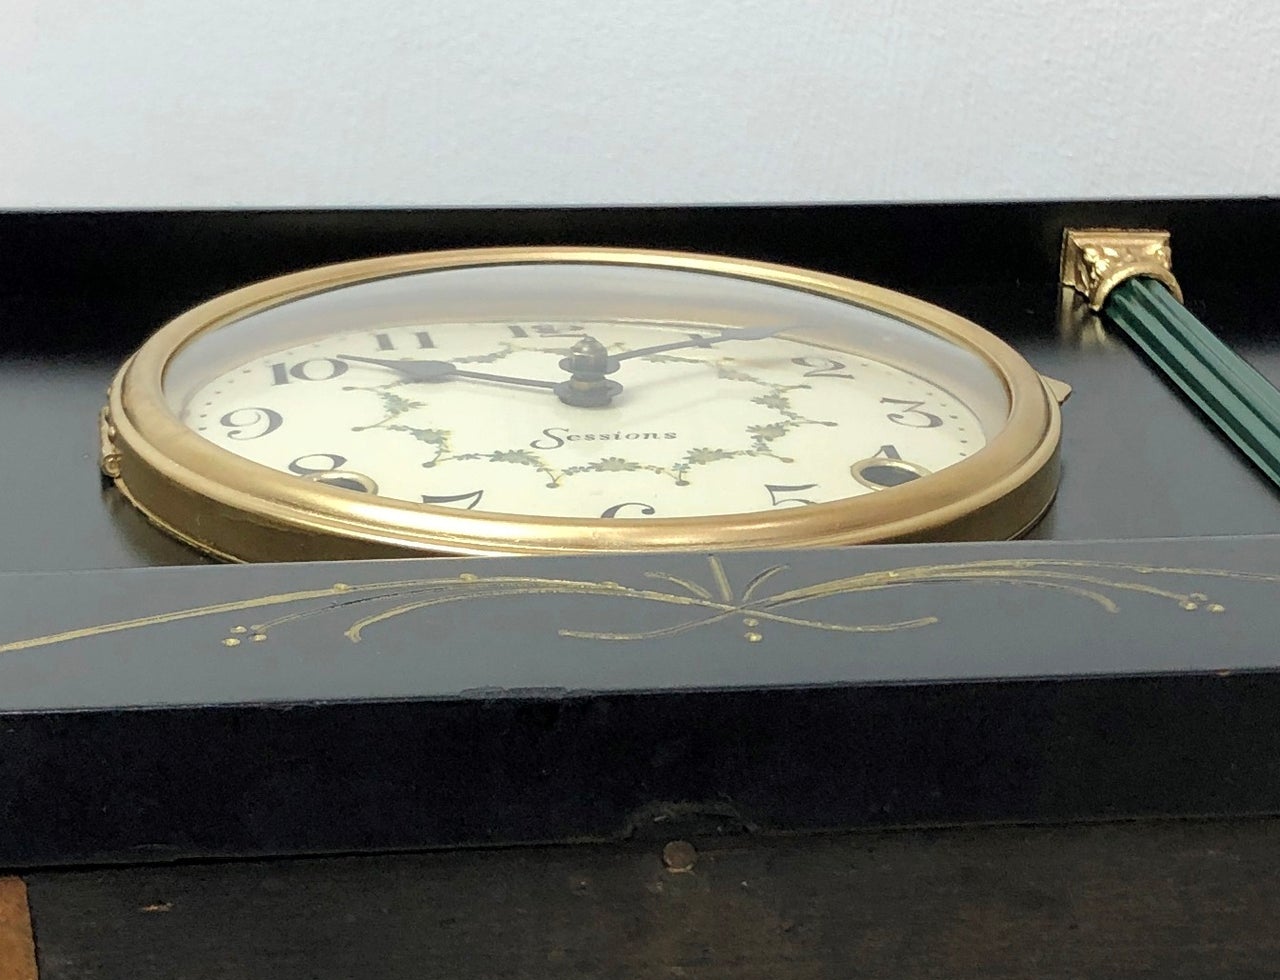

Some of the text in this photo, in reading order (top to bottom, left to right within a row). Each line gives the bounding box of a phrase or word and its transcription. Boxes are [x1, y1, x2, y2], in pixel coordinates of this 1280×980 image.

[375, 331, 437, 351] 11
[271, 358, 349, 386] 10
[791, 357, 855, 379] 2
[220, 407, 283, 440] 9
[880, 397, 943, 428] 3
[530, 427, 678, 450] Sessions
